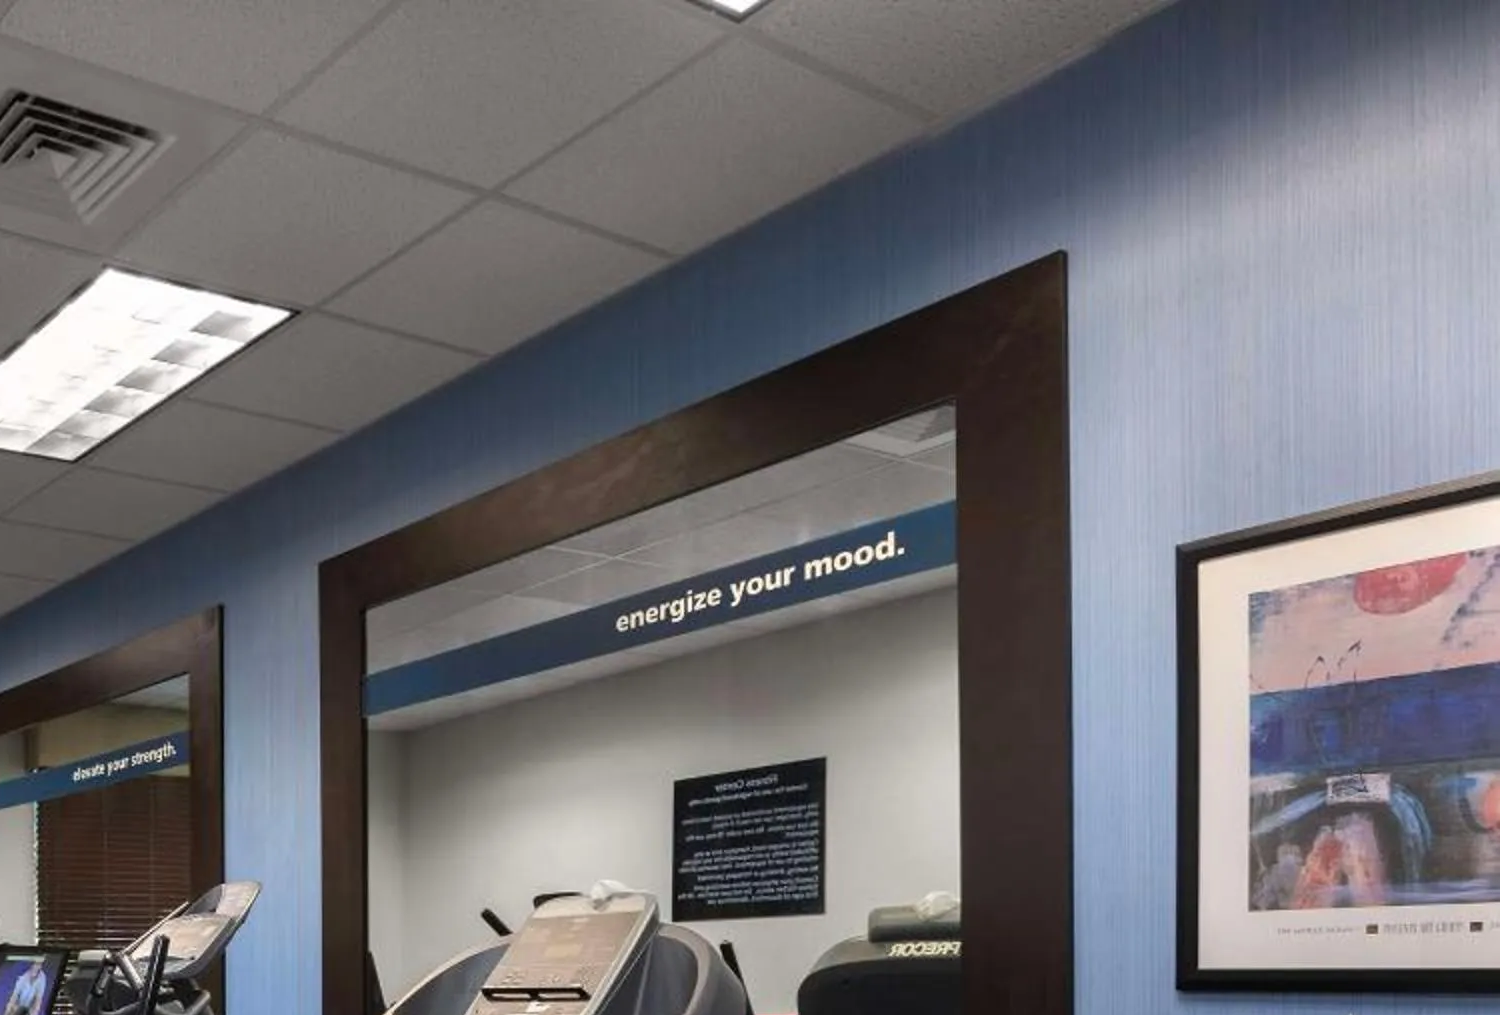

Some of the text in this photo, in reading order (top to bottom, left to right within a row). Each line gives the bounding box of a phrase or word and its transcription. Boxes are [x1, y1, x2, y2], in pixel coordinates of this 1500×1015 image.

[615, 530, 906, 632] energize your mood.
[106, 756, 129, 777] your
